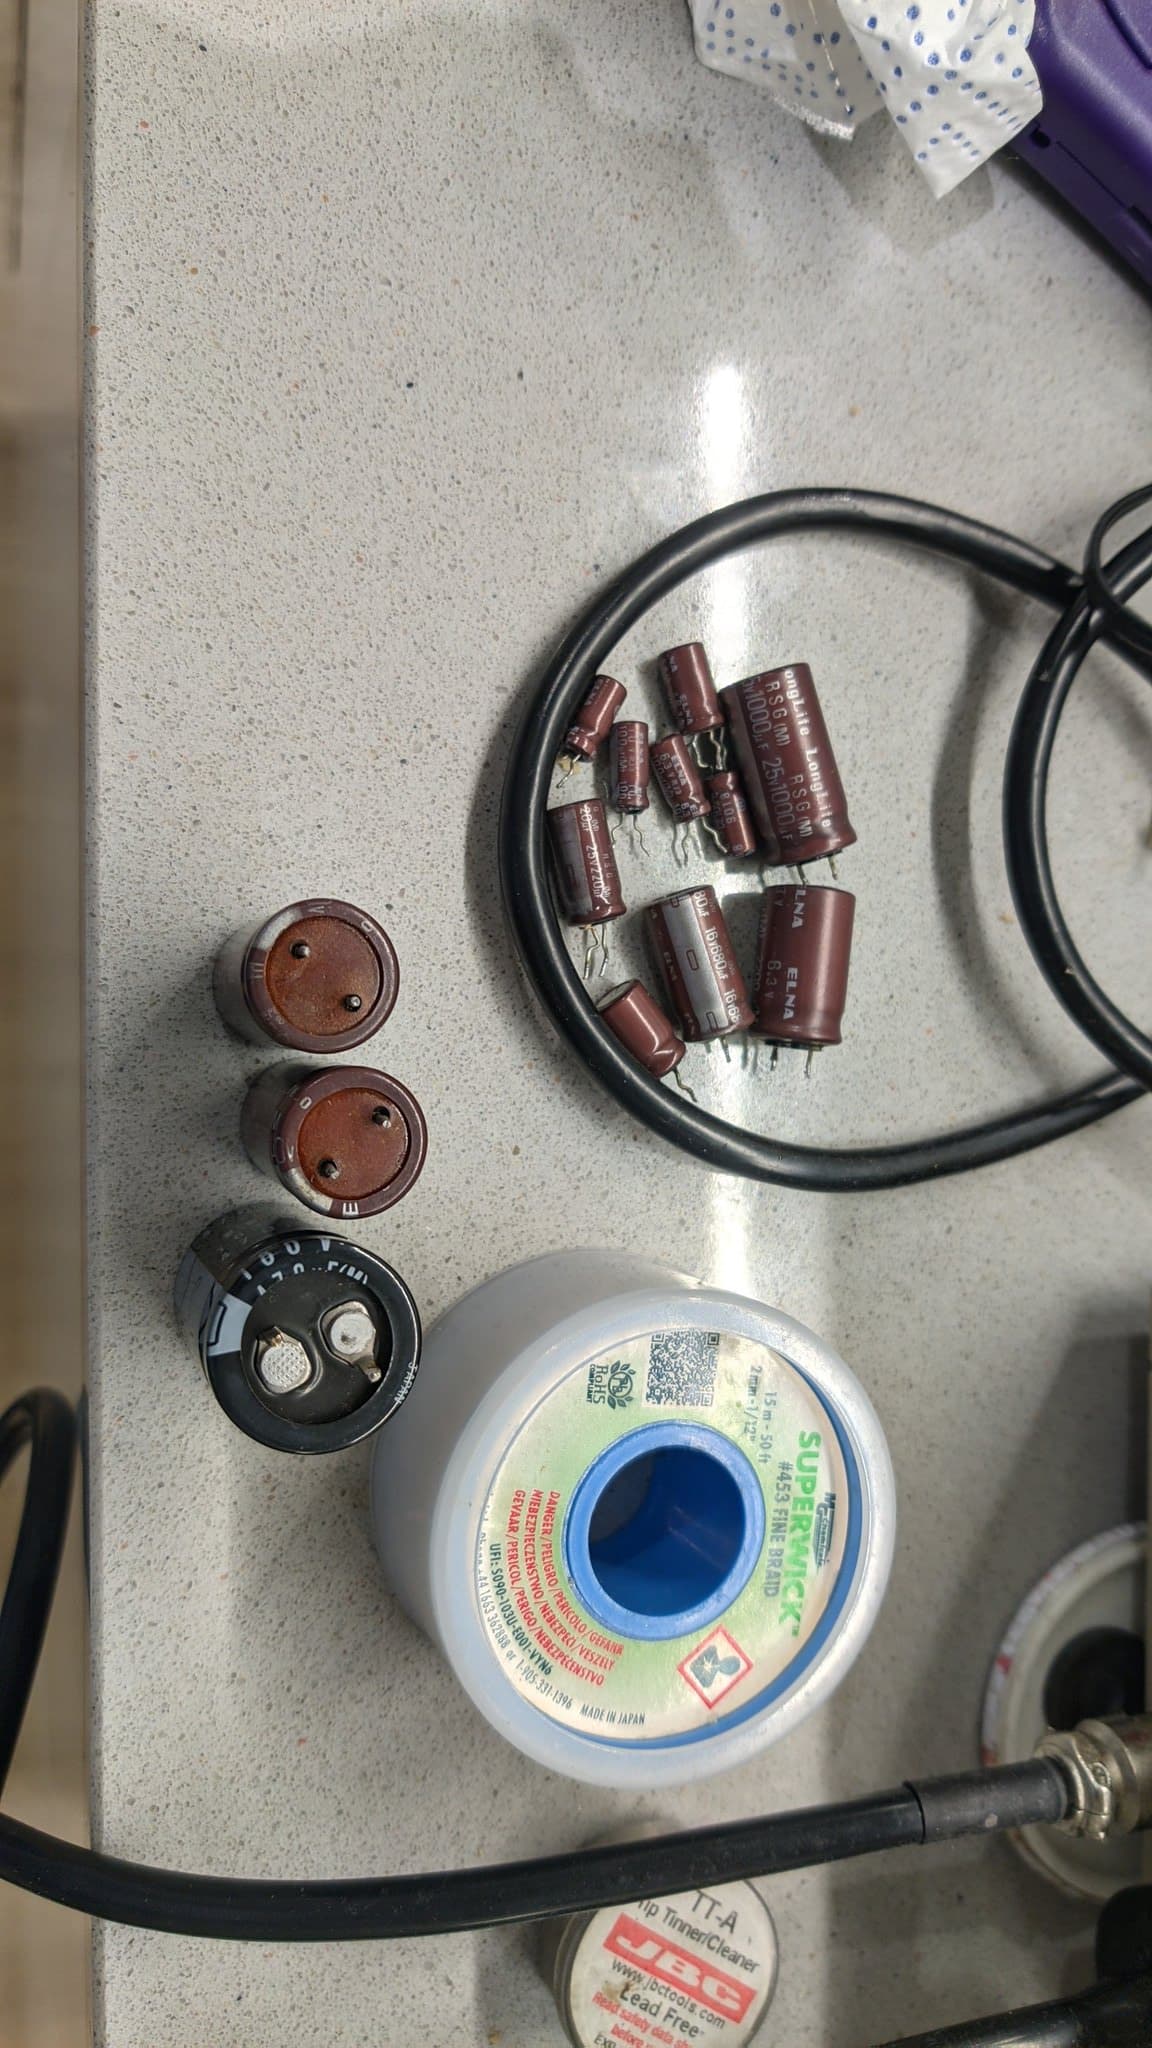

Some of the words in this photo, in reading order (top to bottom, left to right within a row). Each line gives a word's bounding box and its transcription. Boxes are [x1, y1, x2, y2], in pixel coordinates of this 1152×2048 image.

[784, 670, 811, 737] ongLife
[804, 747, 833, 829] LongLife
[791, 887, 807, 929] LNA
[783, 967, 799, 1020] ELNA
[586, 1363, 596, 1404] COMPLIANT
[592, 1365, 609, 1405] RoHS
[763, 1391, 778, 1407] 15
[762, 1410, 772, 1421] m
[757, 1453, 772, 1464] ft
[759, 1433, 773, 1450] 50
[774, 1461, 795, 1503] #453
[769, 1508, 789, 1544] FINE
[490, 1543, 502, 1567] UFI:
[763, 1547, 786, 1598] BRAID
[579, 1704, 607, 1723] MADE
[605, 1710, 617, 1724] IN
[617, 1712, 647, 1727] JAPAN
[690, 1889, 739, 1935] TT-A
[662, 1905, 760, 1973] Tinner/Cleaner
[611, 1958, 726, 2030] www.jbctools.com
[615, 1935, 742, 2012] JBC
[620, 1983, 664, 2017] Lead
[663, 2007, 700, 2038] Free
